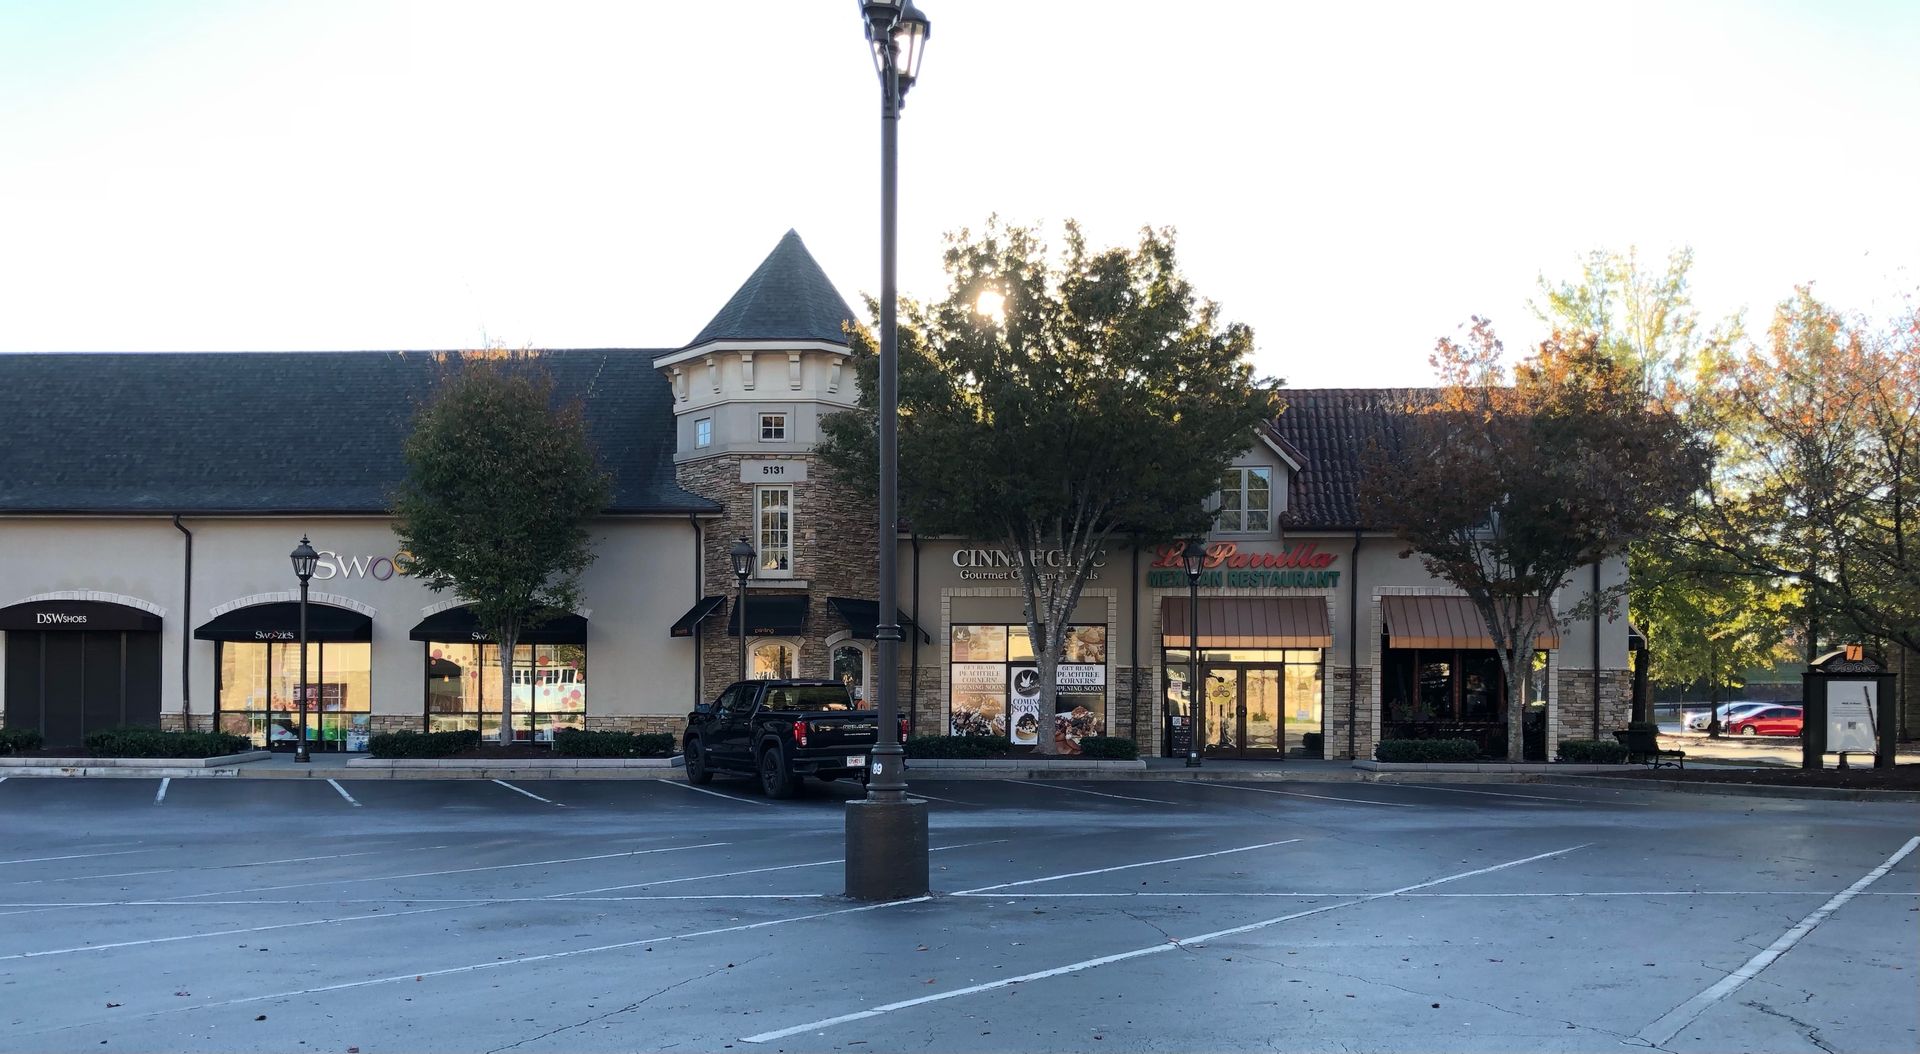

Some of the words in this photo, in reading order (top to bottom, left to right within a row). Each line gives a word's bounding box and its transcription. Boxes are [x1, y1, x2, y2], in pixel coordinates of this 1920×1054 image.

[762, 465, 784, 475] 5131
[1204, 541, 1339, 568] Parrilla
[960, 569, 1008, 580] Gourmet
[1228, 571, 1341, 588] RESTAURANT
[872, 762, 883, 775] 89
